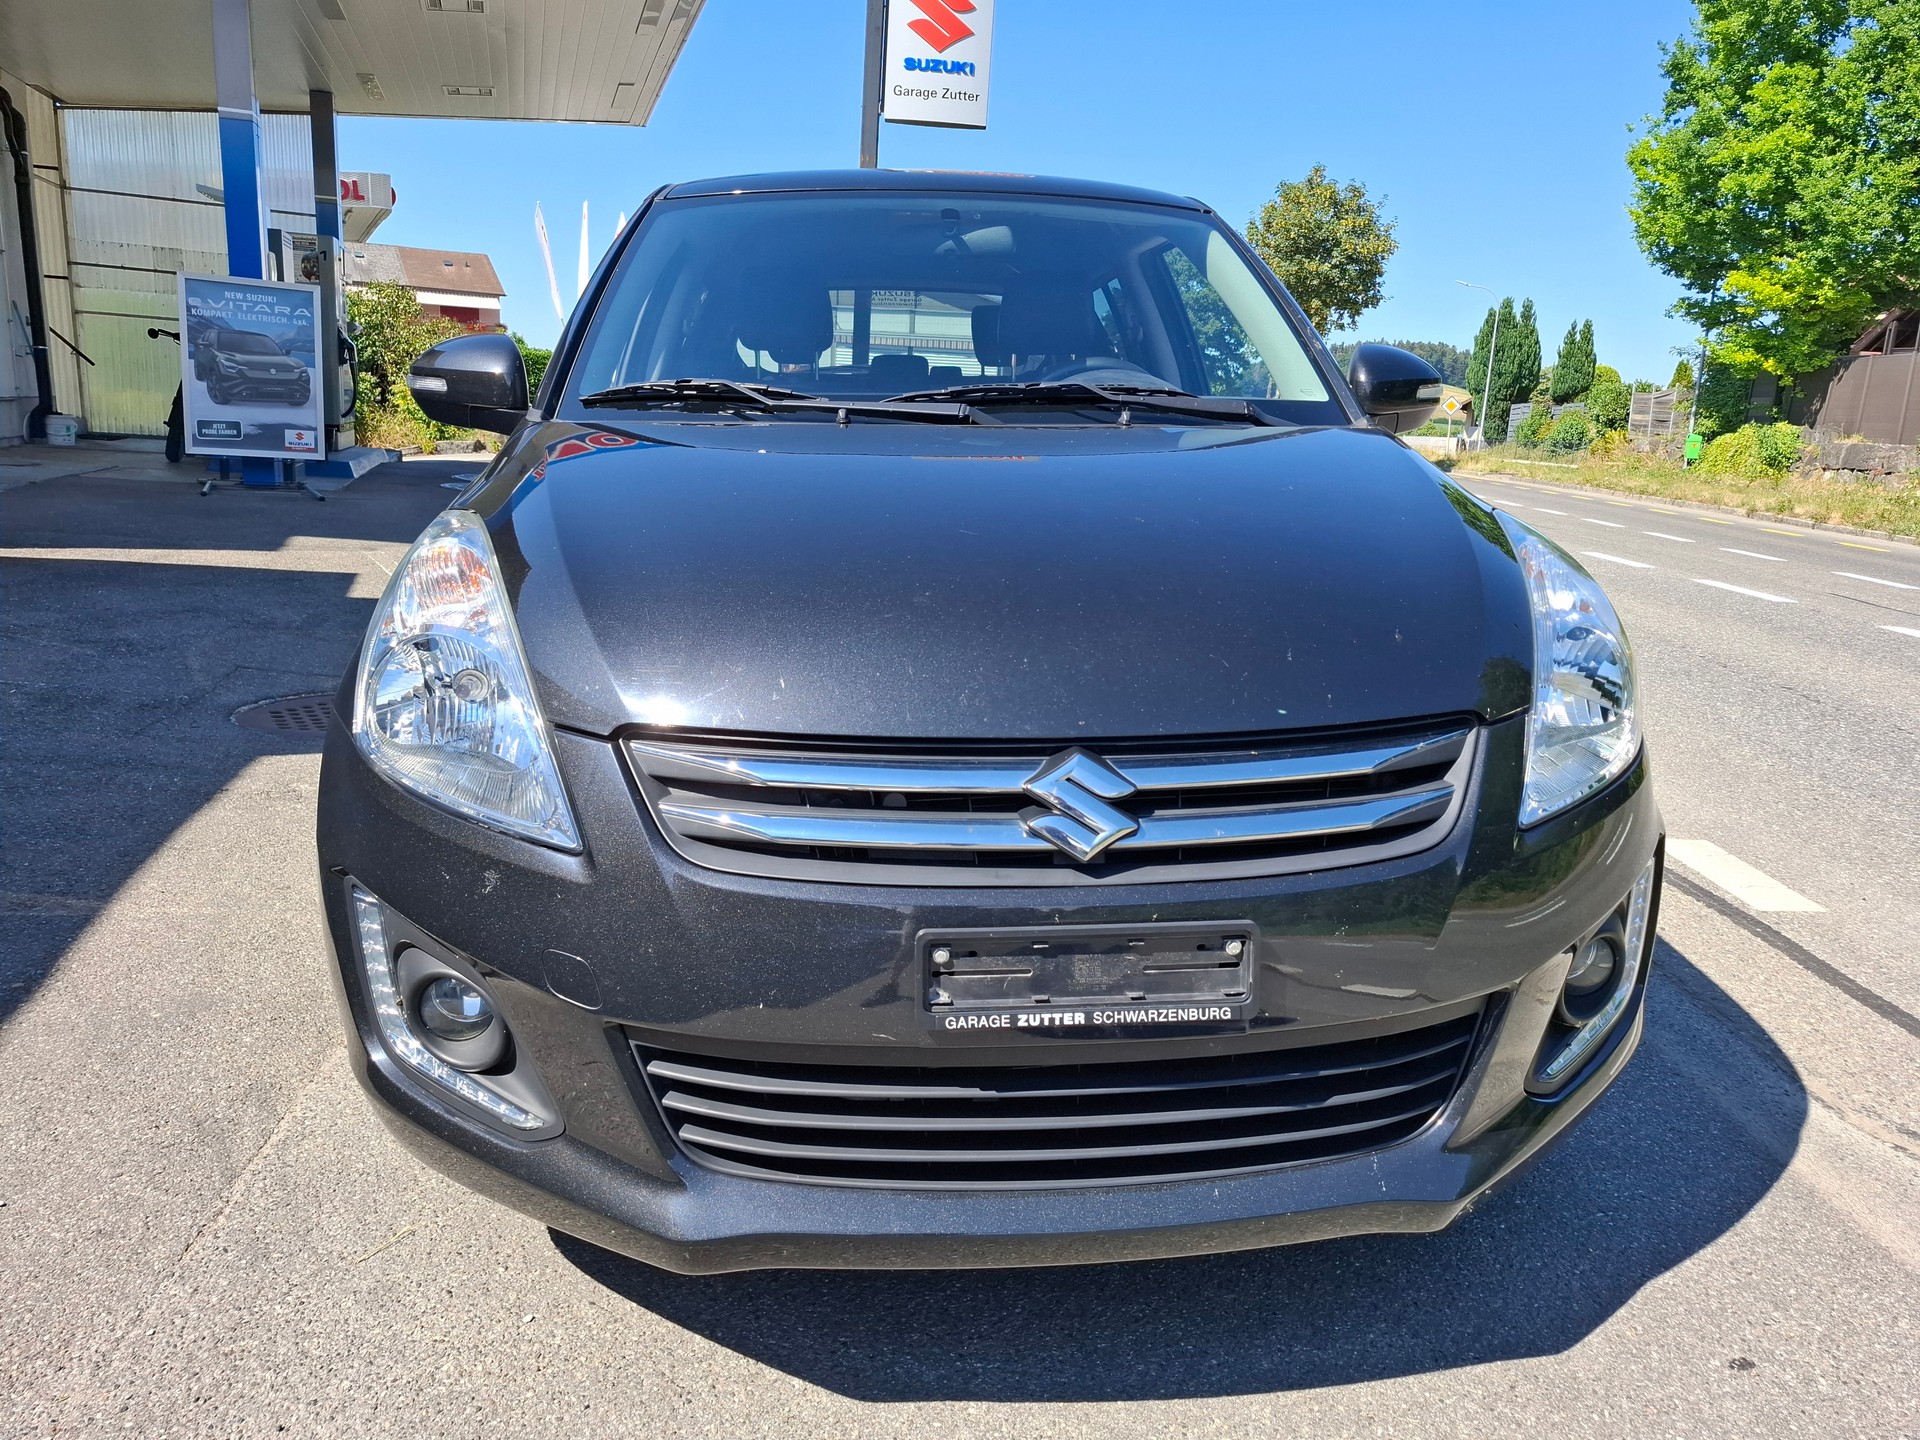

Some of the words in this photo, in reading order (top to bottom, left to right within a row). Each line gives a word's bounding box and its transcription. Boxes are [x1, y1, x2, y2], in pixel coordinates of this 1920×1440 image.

[903, 57, 975, 77] SUZUKI
[893, 85, 938, 100] Garage
[941, 88, 980, 102] Zutter
[320, 250, 327, 261] 1
[225, 291, 243, 300] NEW
[246, 293, 277, 303] SUZUKI
[191, 308, 234, 318] KOMPAKT.
[238, 313, 290, 324] ELEKTRISCH.
[208, 299, 312, 317] VITARA
[945, 1015, 1011, 1030] GARAGE
[1017, 1012, 1085, 1027] ZUTTER
[1093, 1007, 1232, 1025] SCHWARZENBURG
